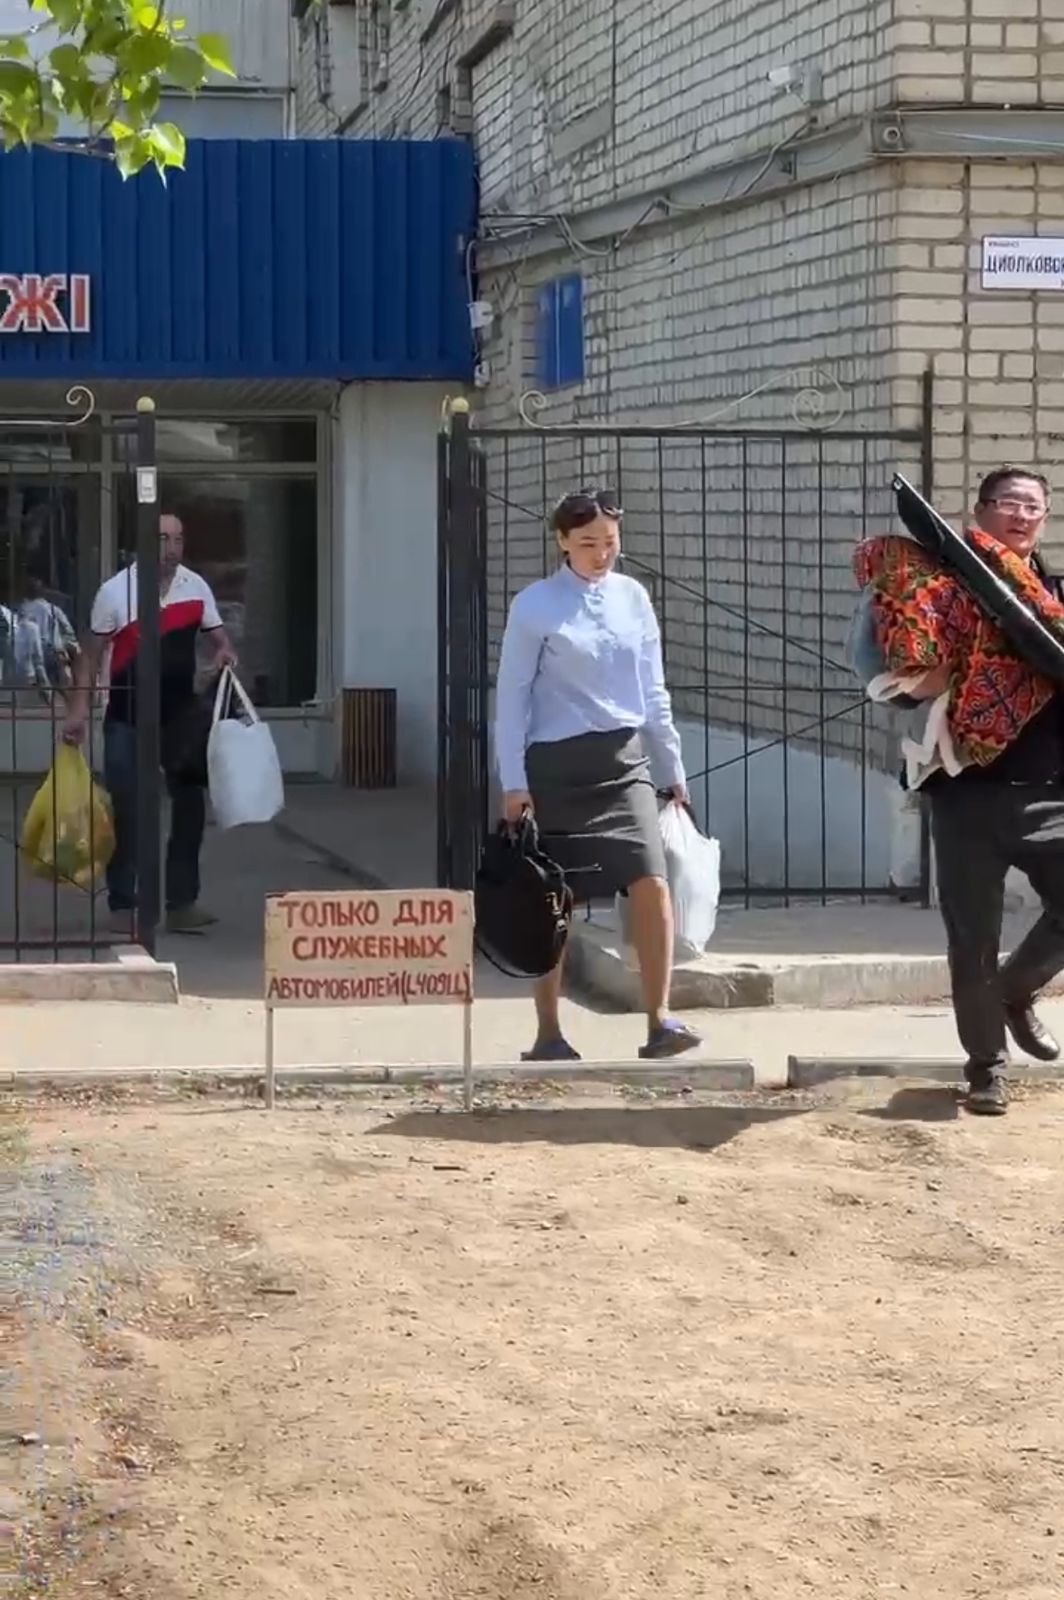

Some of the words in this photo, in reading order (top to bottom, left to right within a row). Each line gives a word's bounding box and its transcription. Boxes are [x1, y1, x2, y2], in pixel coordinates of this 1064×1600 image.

[277, 900, 380, 928] ТОЛЬКО
[392, 900, 453, 927] ДЛЯ
[292, 934, 447, 960] СЛУЖЕБНЫХ
